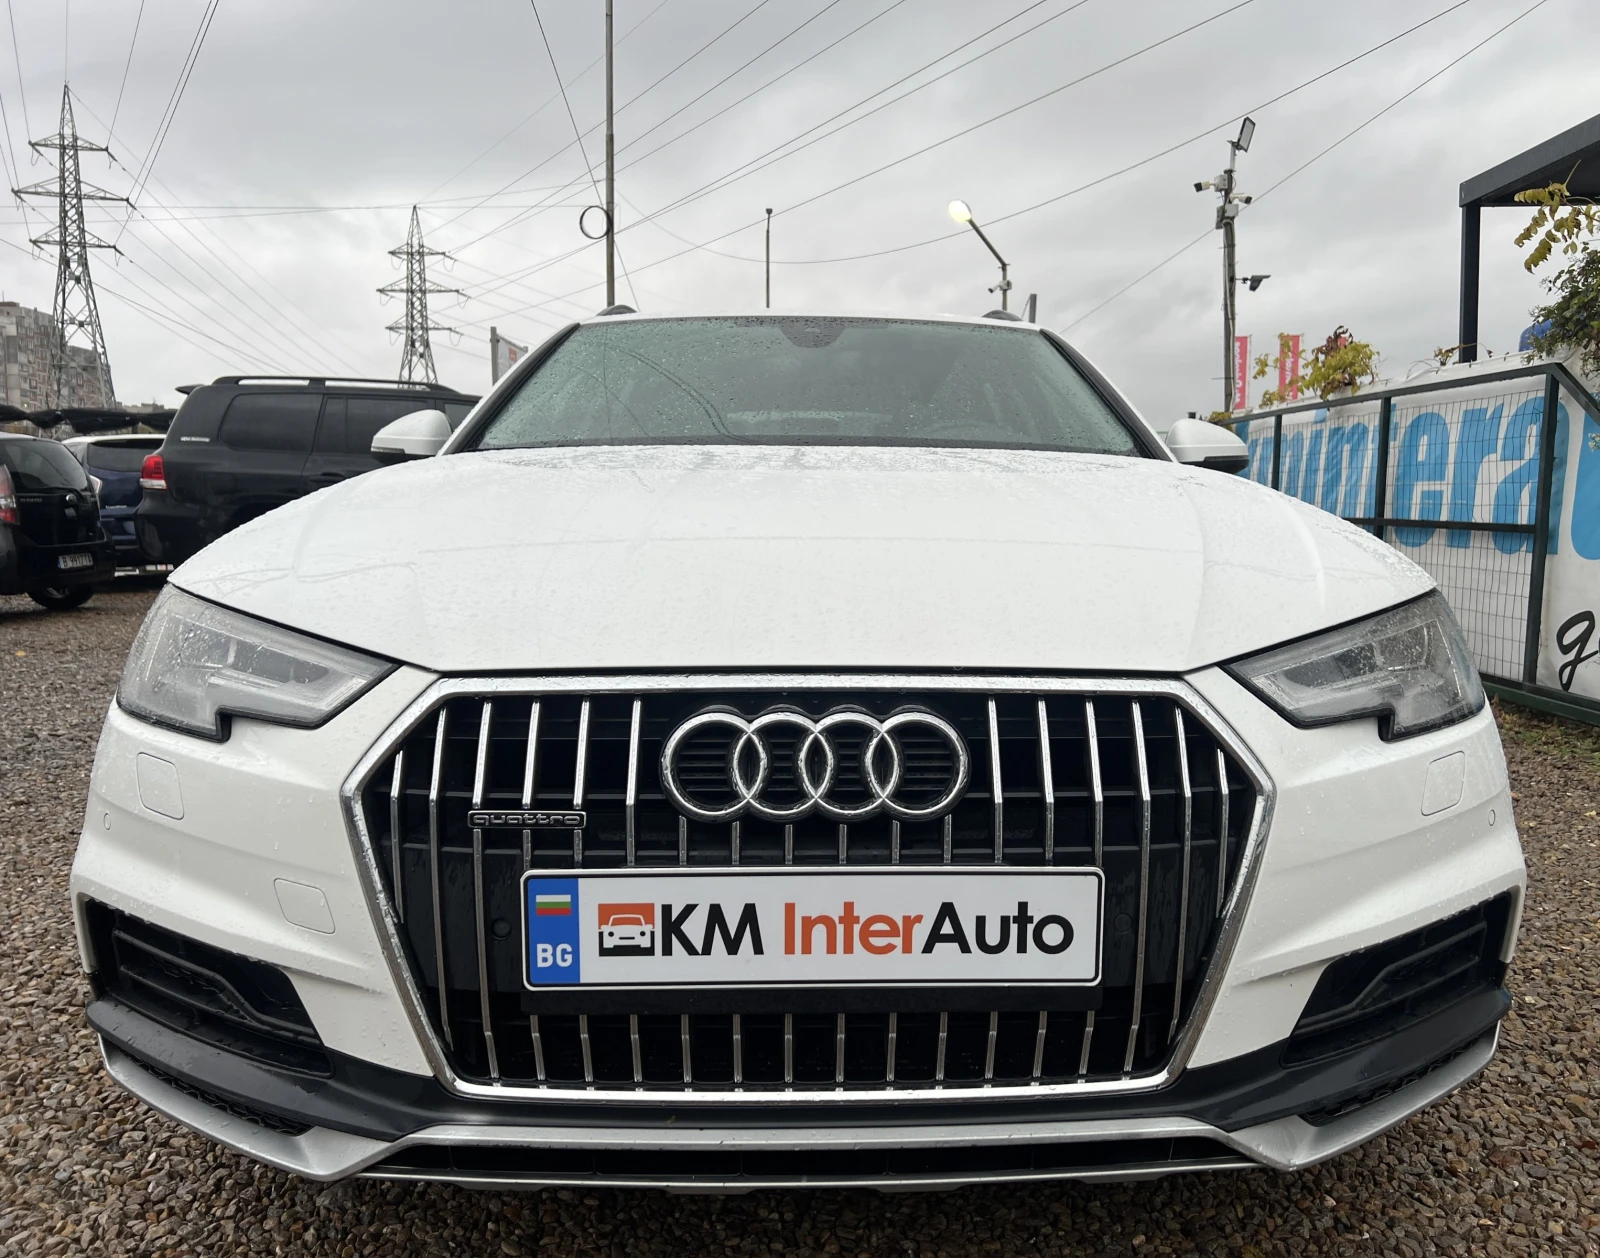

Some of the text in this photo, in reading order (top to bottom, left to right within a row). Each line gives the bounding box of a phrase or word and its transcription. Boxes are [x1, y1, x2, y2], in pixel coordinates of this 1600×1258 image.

[1556, 610, 1600, 692] g
[473, 814, 580, 826] quattro
[662, 901, 1074, 956] KM InterAuto
[536, 943, 573, 968] BG
